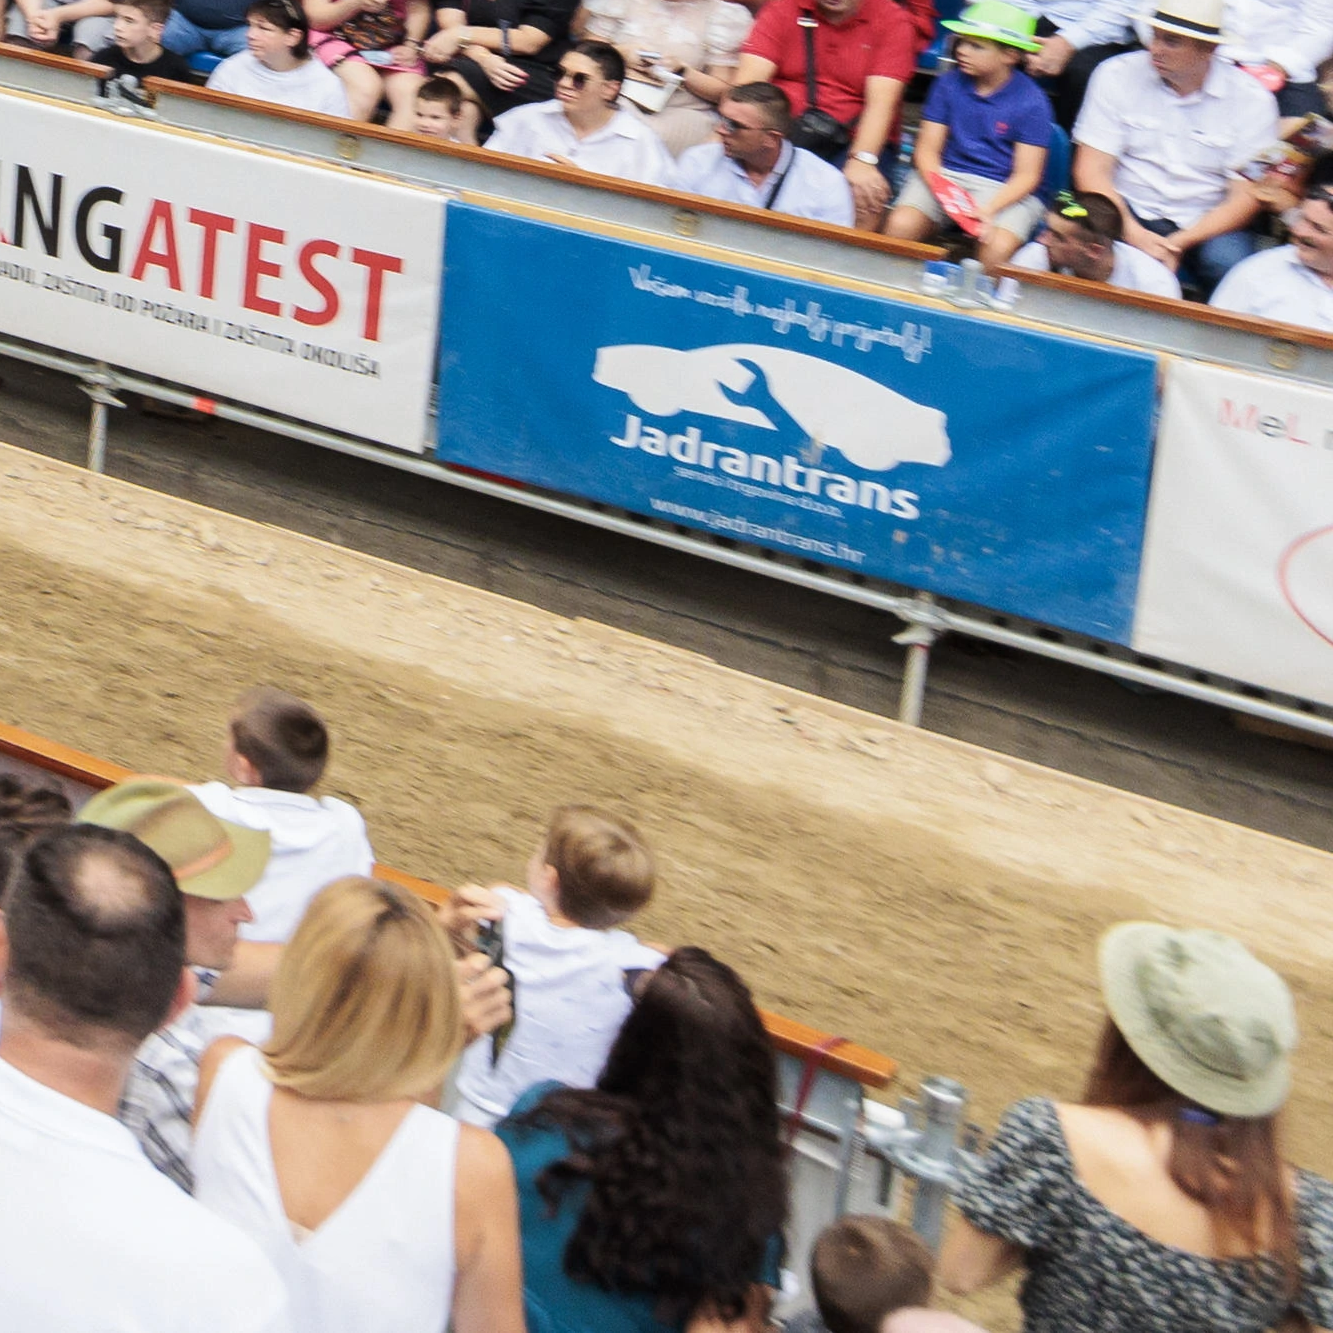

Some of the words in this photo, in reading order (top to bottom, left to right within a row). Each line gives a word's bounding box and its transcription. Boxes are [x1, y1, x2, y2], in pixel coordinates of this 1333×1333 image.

[41, 270, 110, 306] ZAŠTITA
[111, 291, 136, 314] OD
[139, 299, 209, 332] POŽARA
[224, 322, 296, 355] ZAŠTITA
[609, 413, 922, 521] Jadrantrans
[649, 497, 867, 564] www.jadrantrans.hr
